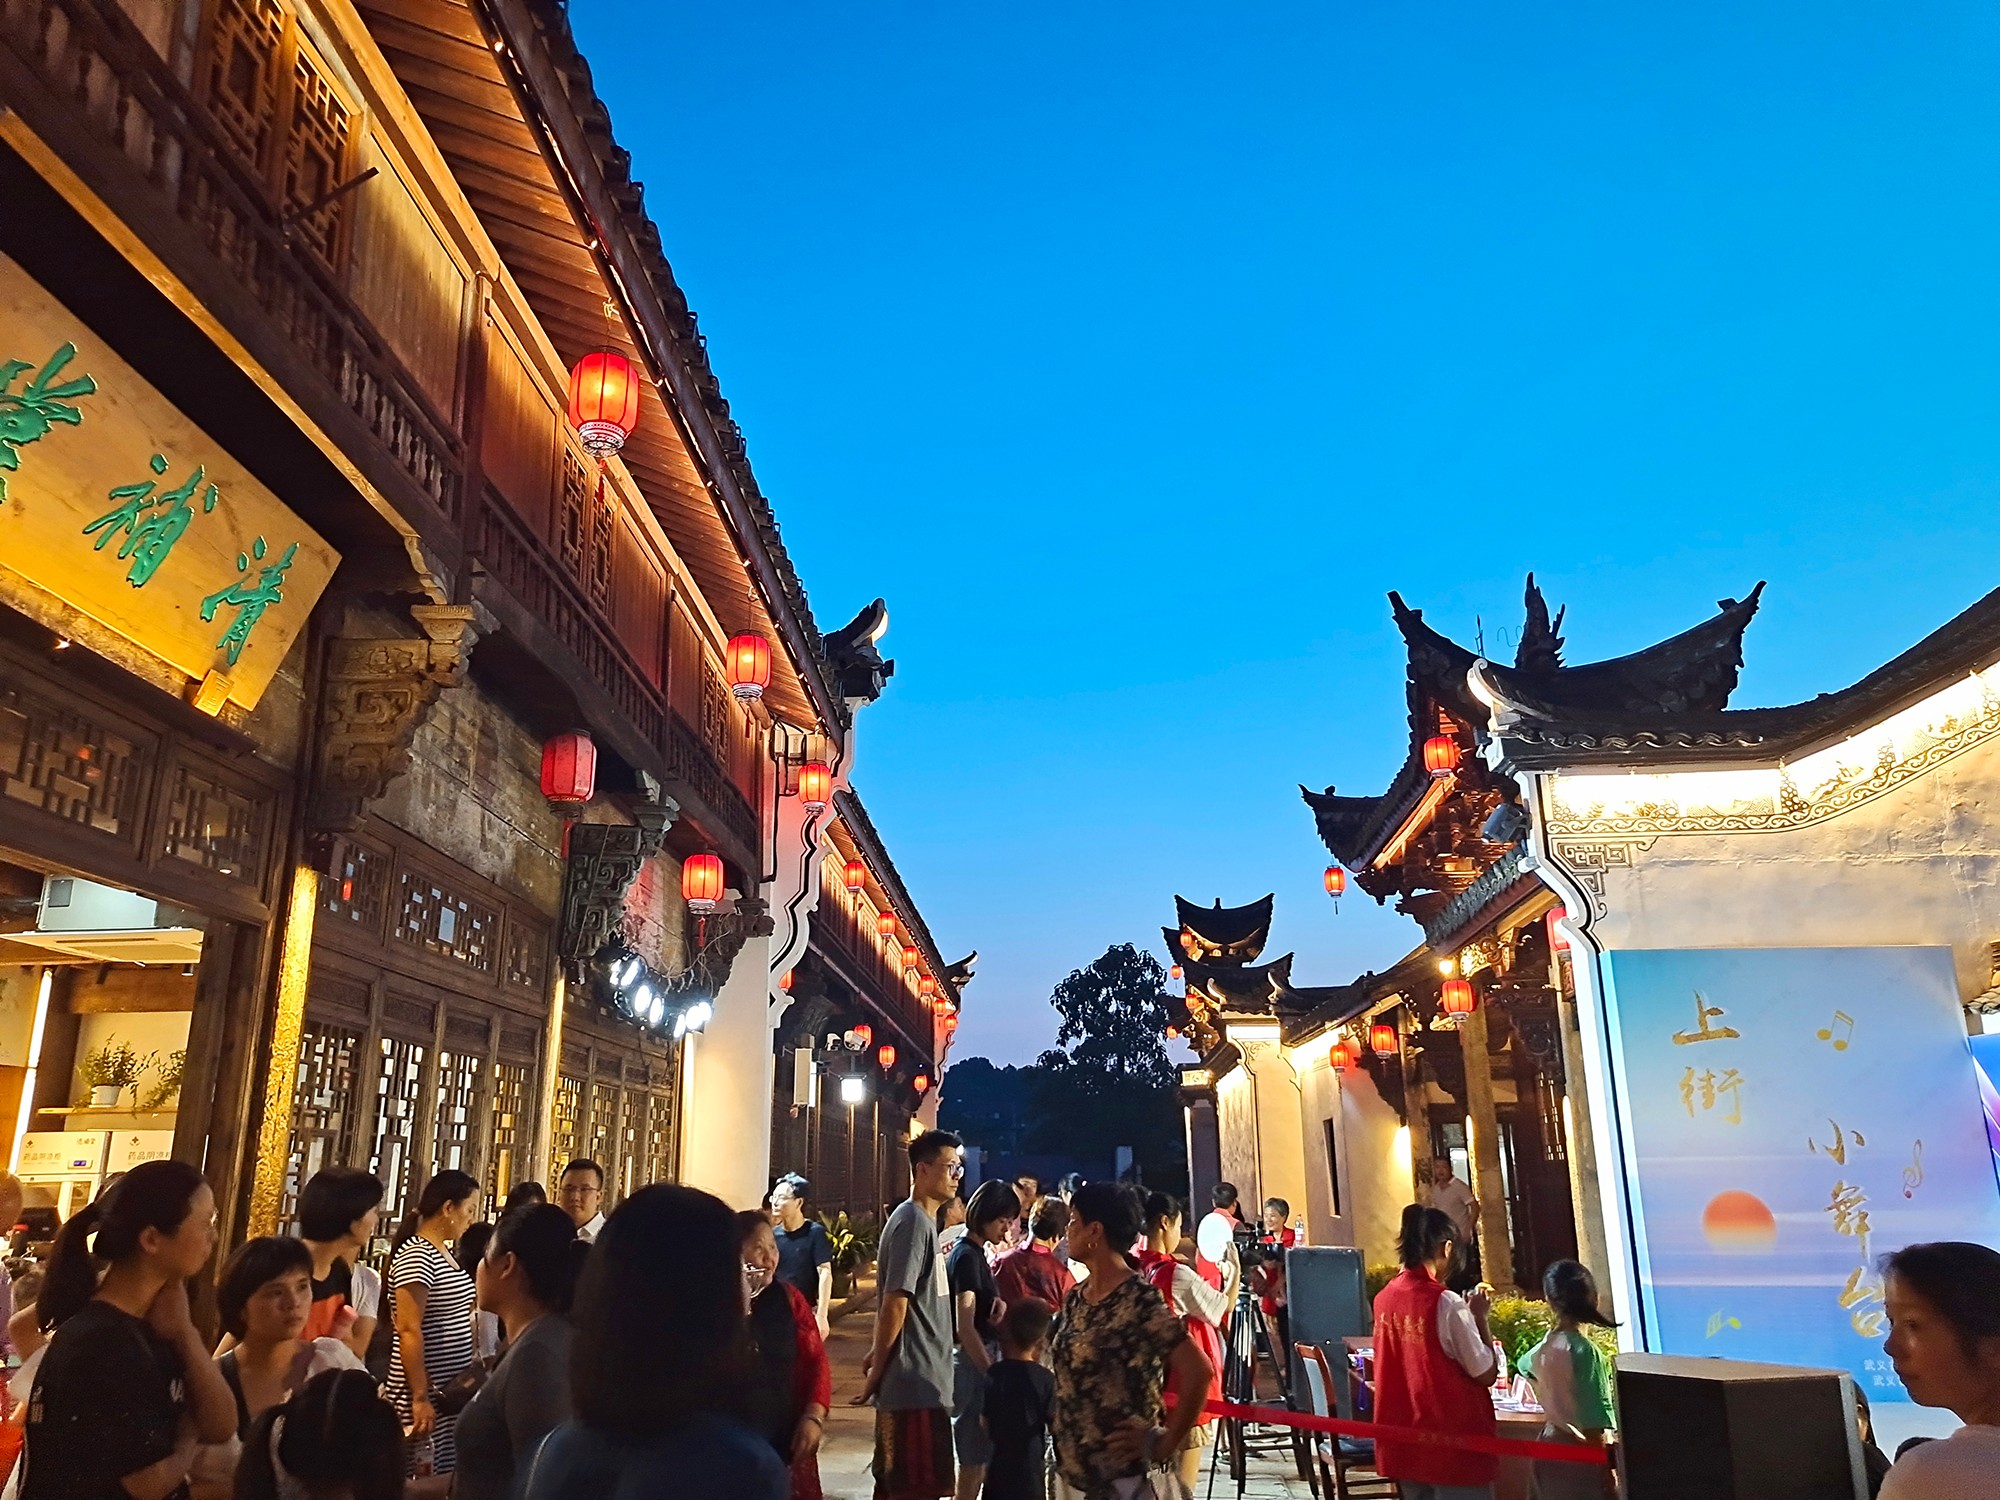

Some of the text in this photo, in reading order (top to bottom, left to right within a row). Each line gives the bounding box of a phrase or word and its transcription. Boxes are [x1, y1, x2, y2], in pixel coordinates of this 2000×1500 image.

[1671, 989, 1745, 1125] 上街
[1807, 1118, 1886, 1338] 小舞台
